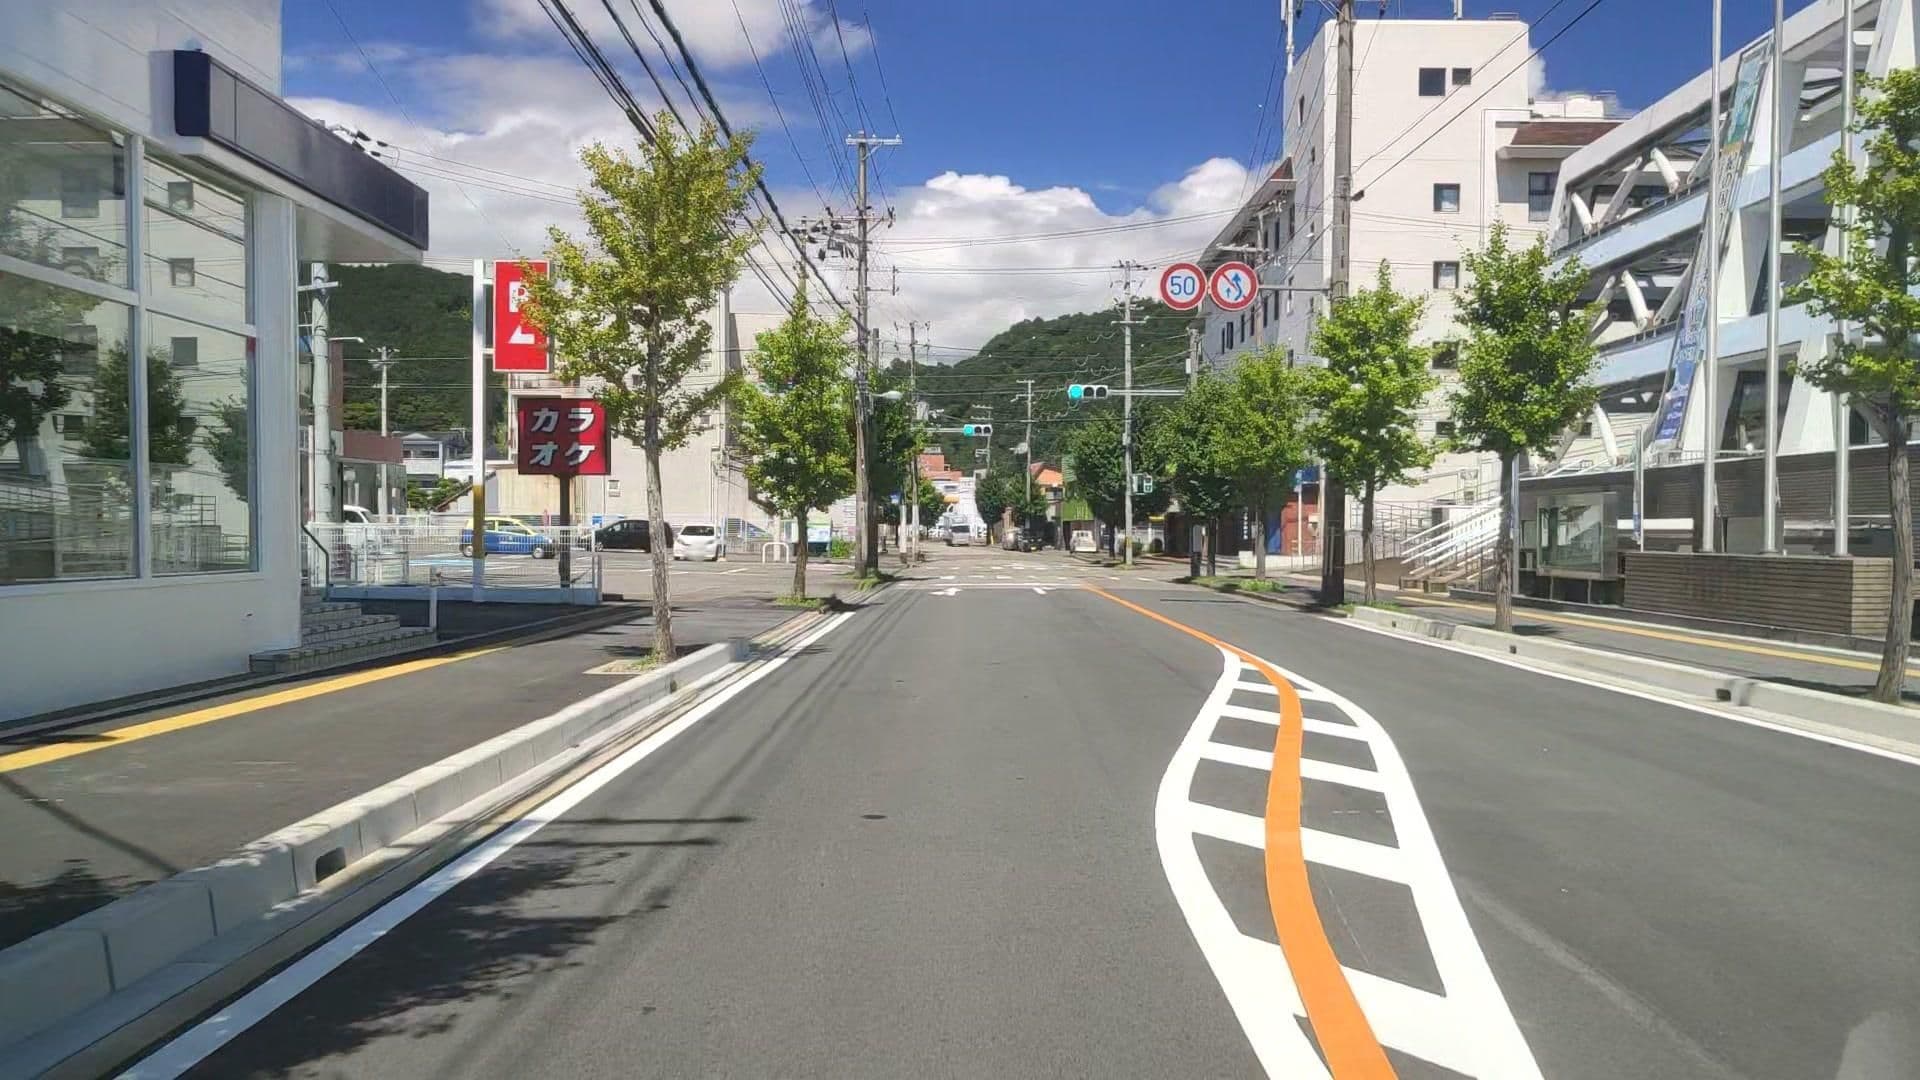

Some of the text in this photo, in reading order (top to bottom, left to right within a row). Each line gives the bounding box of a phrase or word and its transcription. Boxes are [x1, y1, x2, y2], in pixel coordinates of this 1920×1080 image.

[1170, 275, 1195, 296] 50
[530, 407, 595, 433] カラ
[528, 441, 596, 467] オケ
